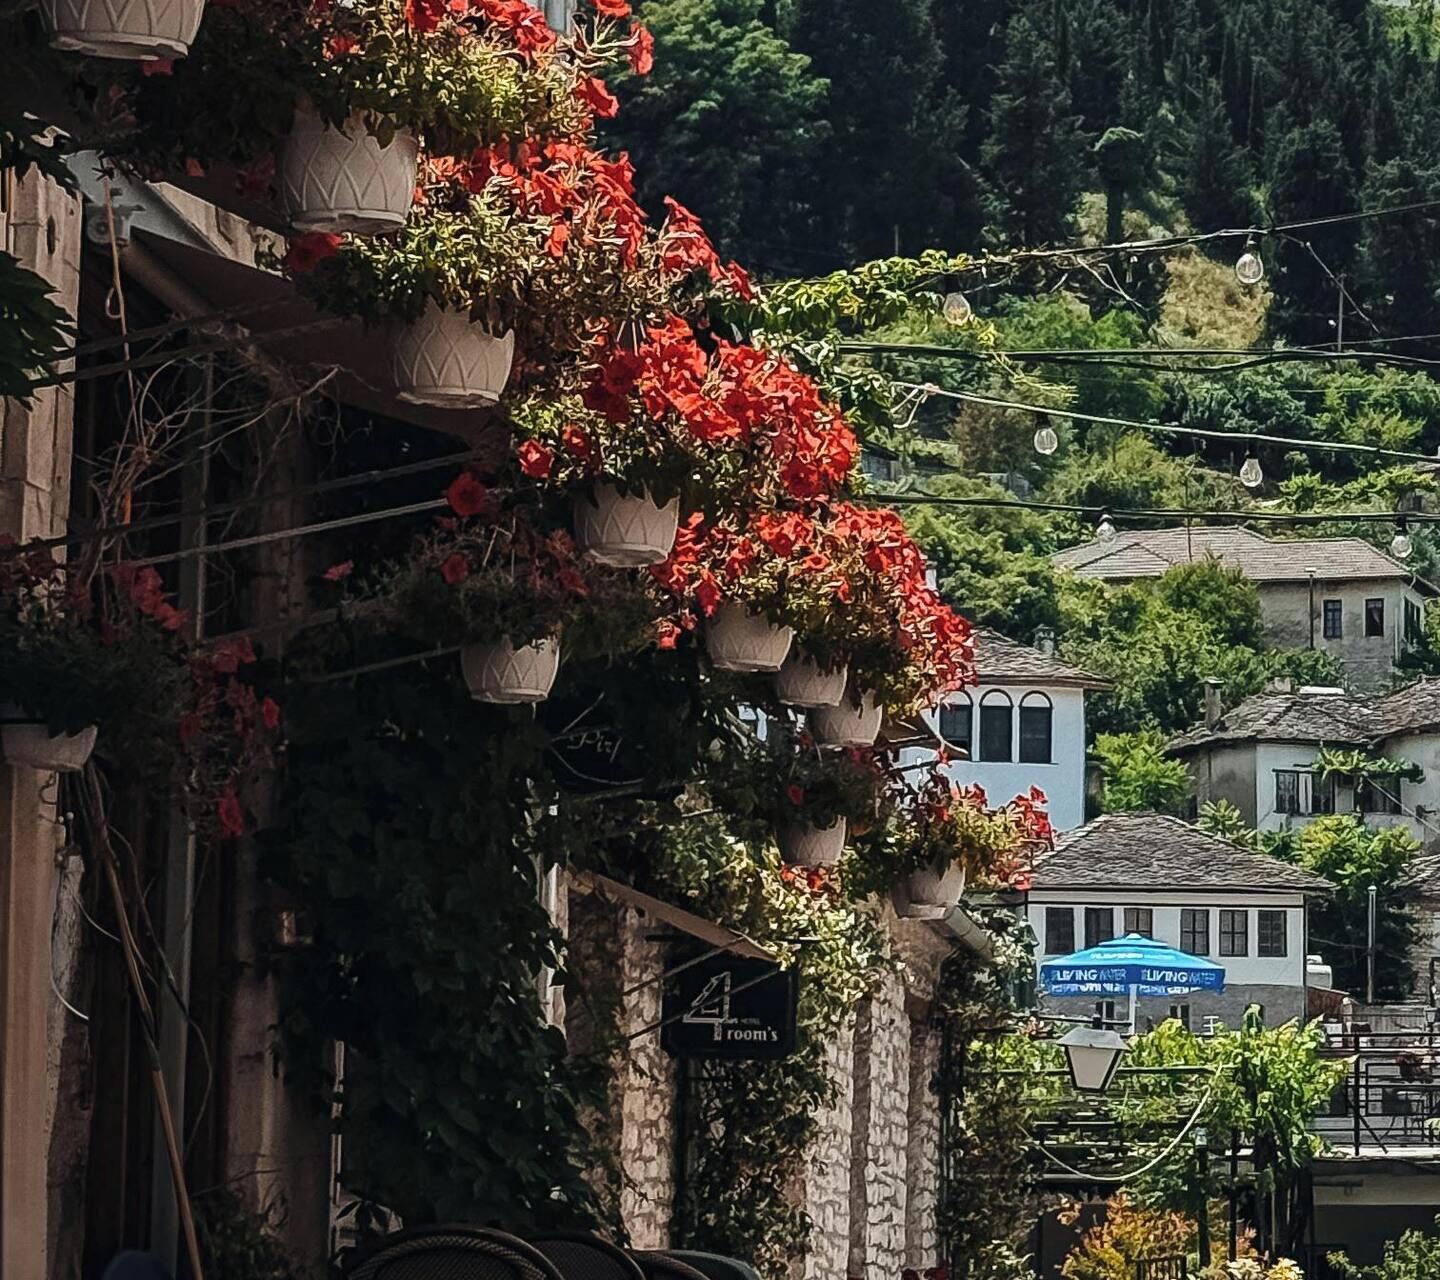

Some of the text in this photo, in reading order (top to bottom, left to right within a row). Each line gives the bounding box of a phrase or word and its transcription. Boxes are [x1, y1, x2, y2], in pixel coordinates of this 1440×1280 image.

[1057, 968, 1098, 981] LIVING
[1147, 968, 1188, 983] LIVING
[681, 970, 779, 1042] 4 room's
